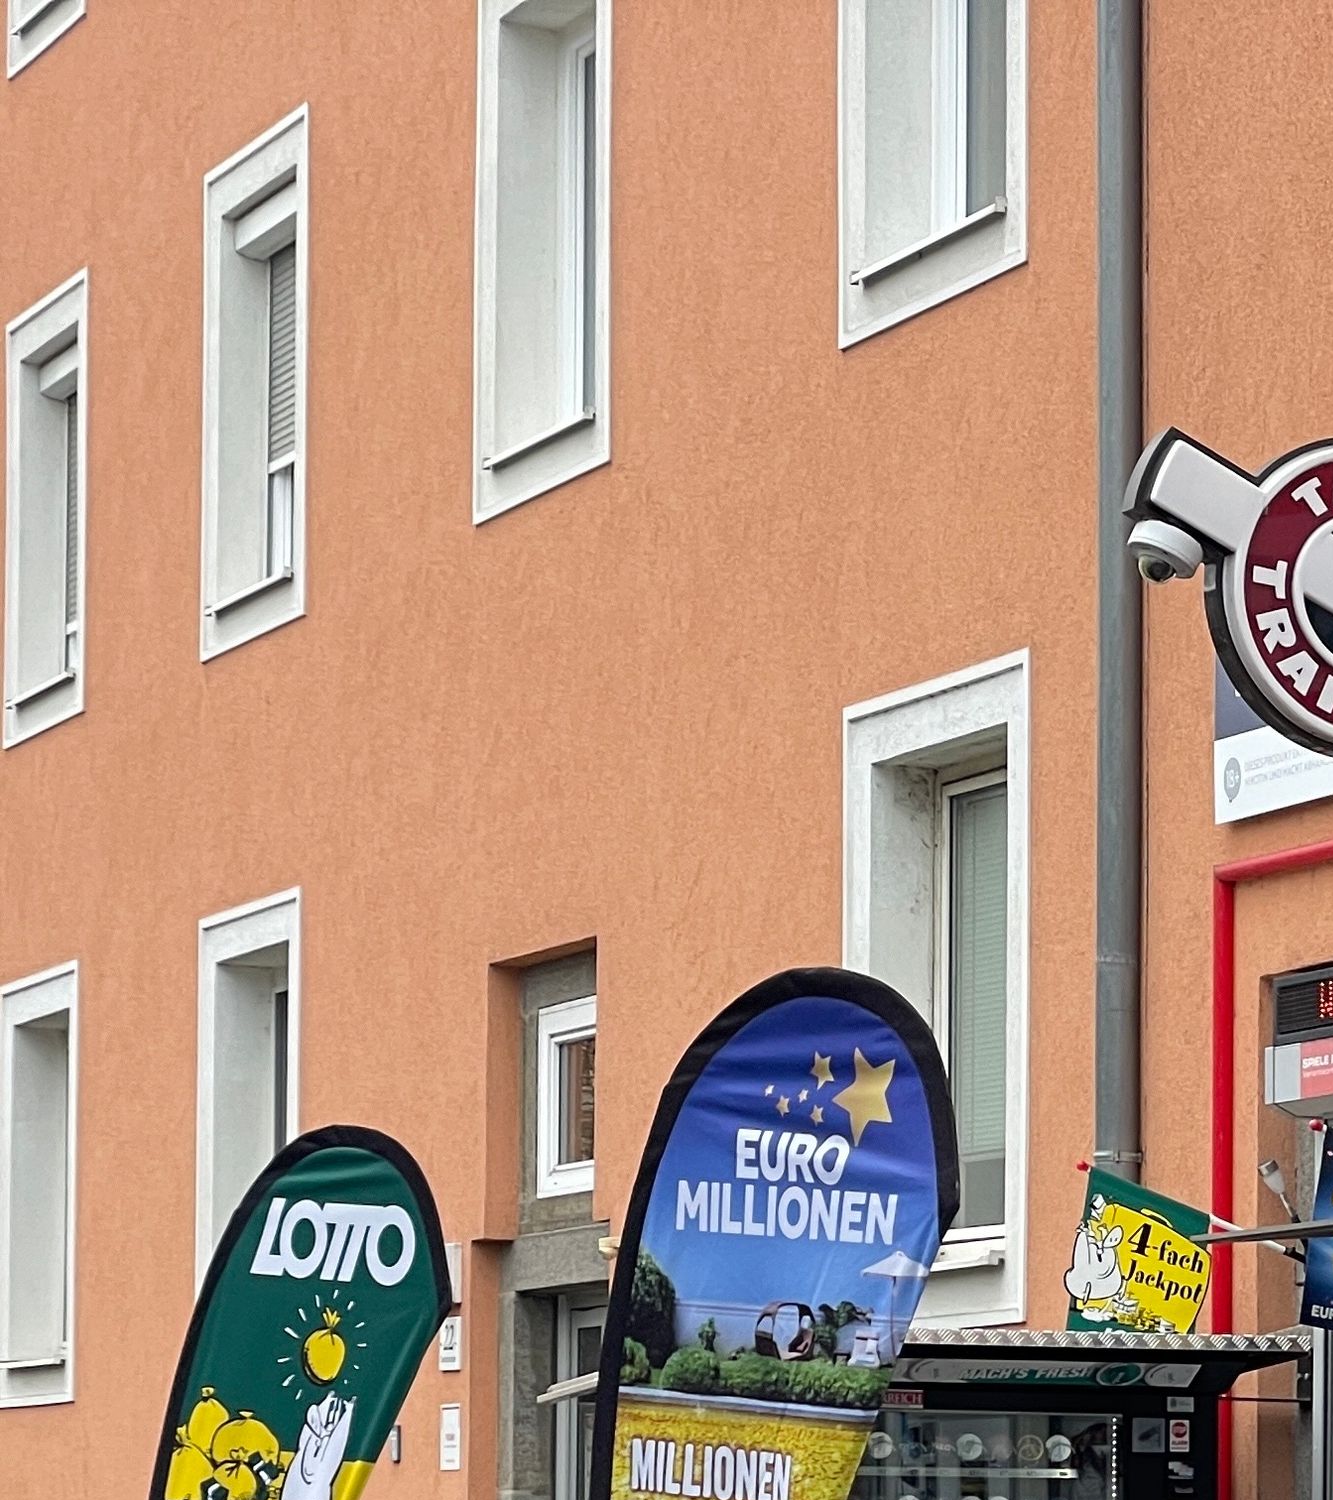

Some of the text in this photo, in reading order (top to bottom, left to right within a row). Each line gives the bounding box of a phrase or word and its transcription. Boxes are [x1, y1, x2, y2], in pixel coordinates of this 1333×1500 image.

[1303, 1054, 1329, 1068] SPIELE
[735, 1128, 851, 1186] EURO
[676, 1180, 898, 1246] MILLIONEN
[250, 1197, 416, 1287] LOTTO
[1127, 1221, 1205, 1275] 4-fach
[1122, 1258, 1206, 1306] Jackpot
[959, 1365, 1093, 1381] MACH'S FRESH
